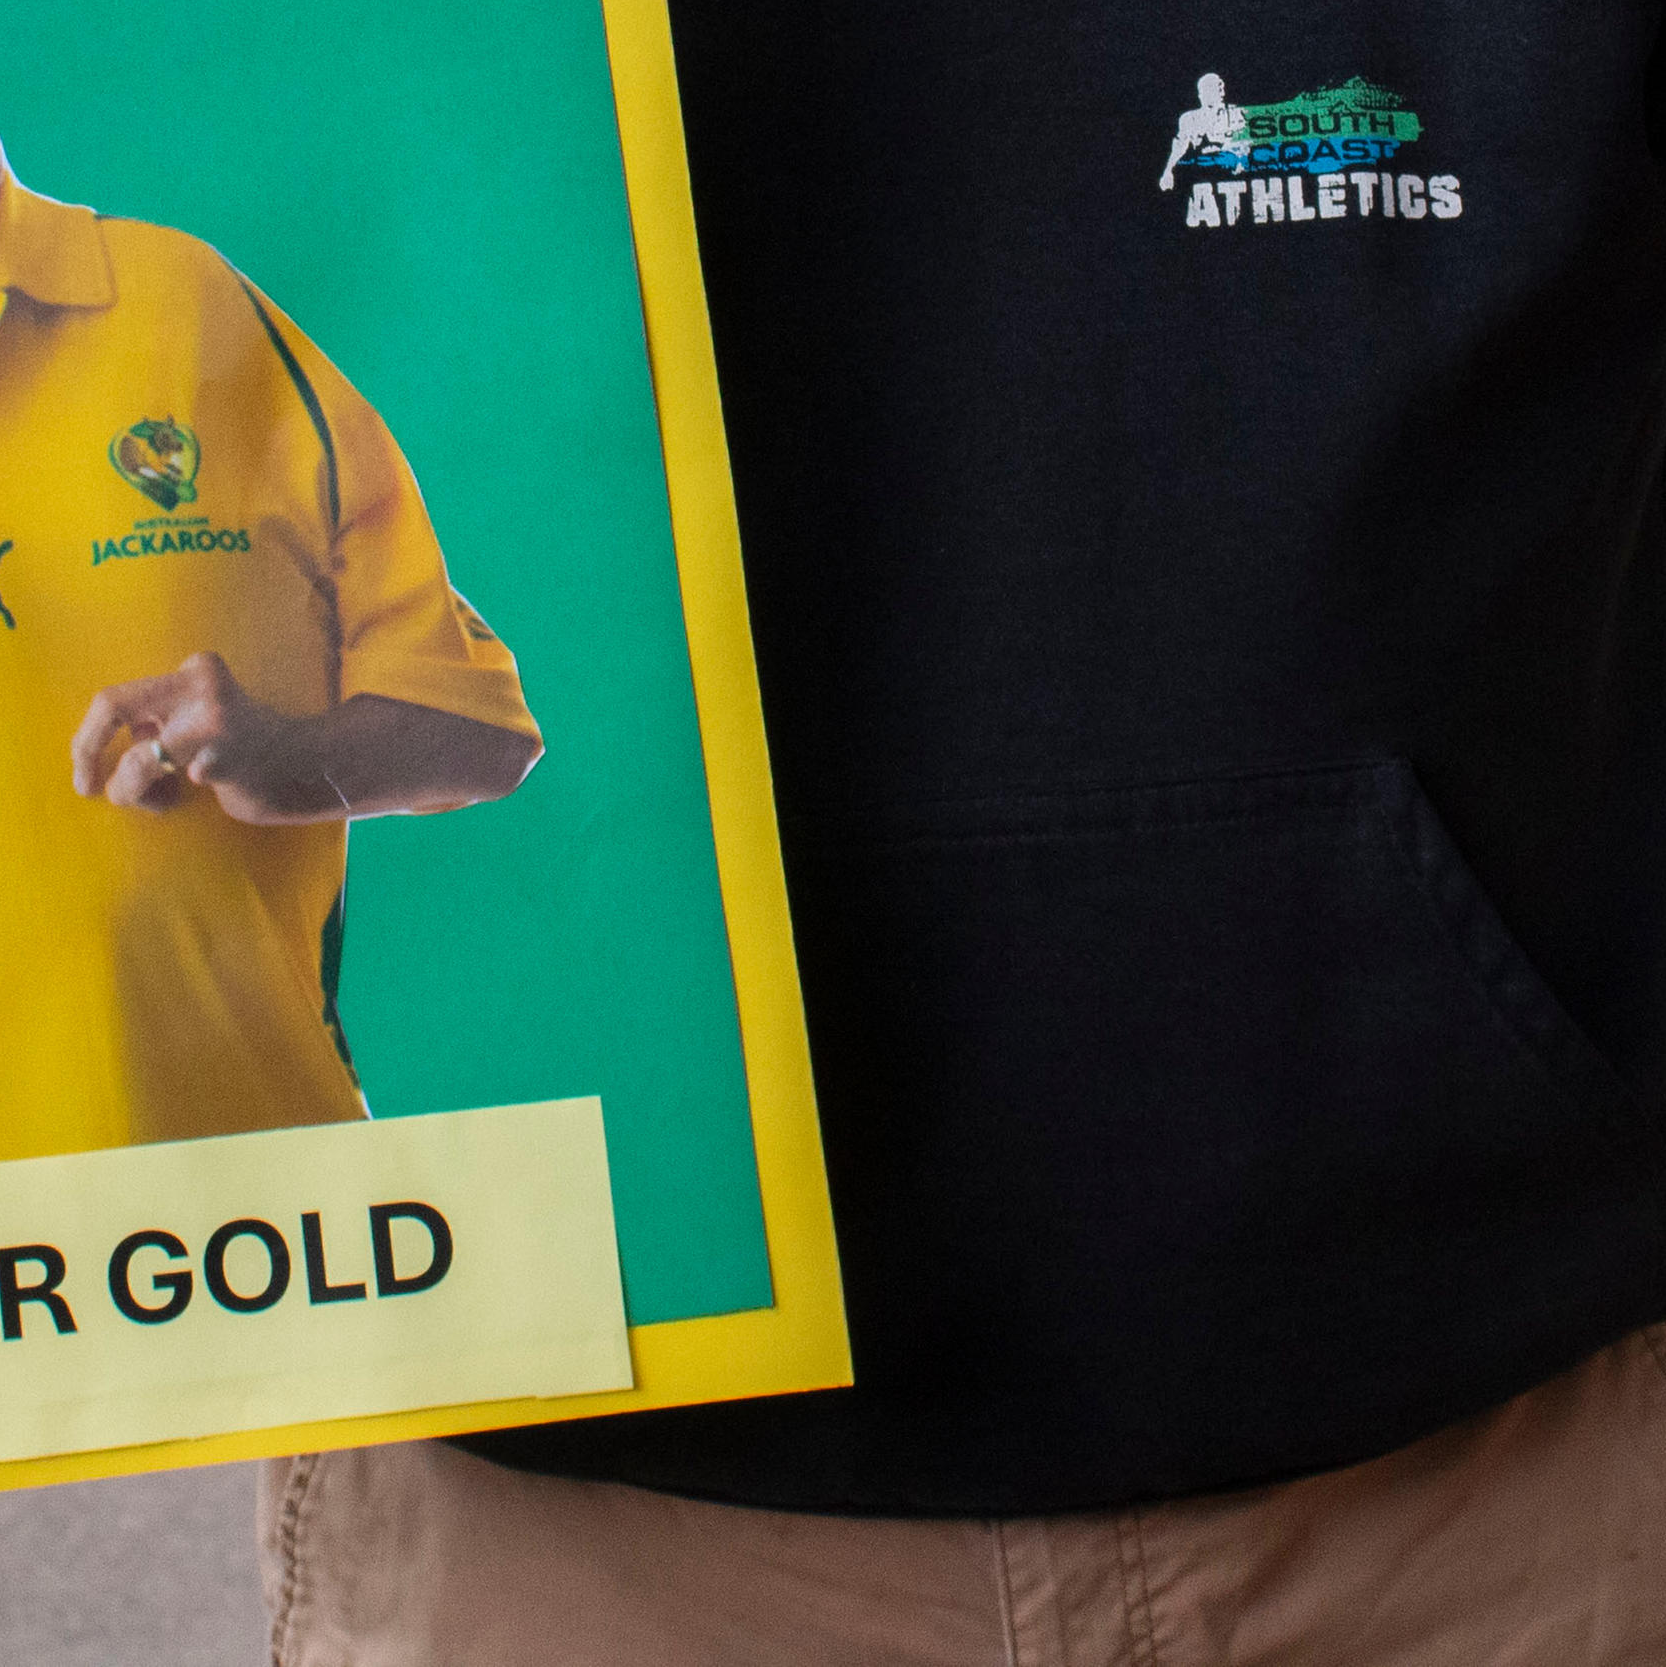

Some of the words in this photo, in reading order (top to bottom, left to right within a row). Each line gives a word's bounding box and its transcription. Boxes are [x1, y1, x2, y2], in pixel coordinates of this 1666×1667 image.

[1248, 111, 1395, 138] SOUTH
[1247, 138, 1397, 166] COAST
[1185, 171, 1464, 228] ATHLETICS
[90, 529, 251, 567] JACKAROOS
[107, 1200, 454, 1326] GOLD
